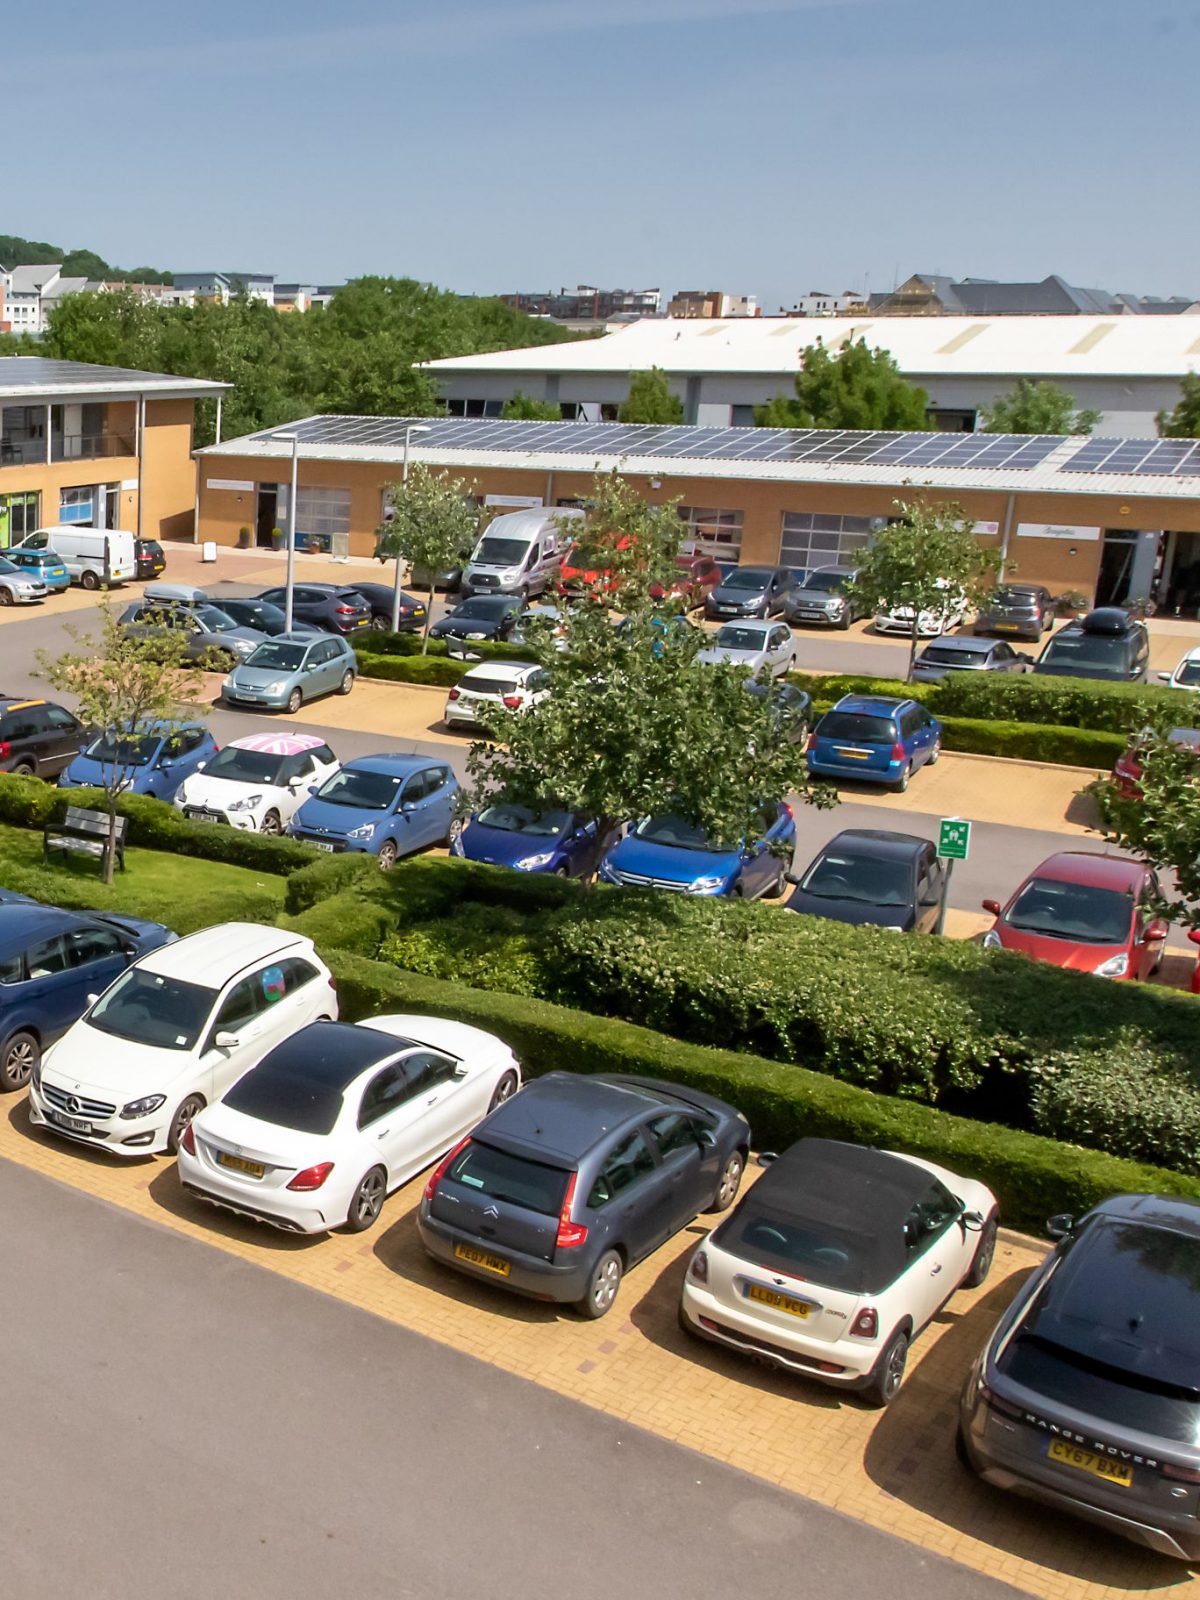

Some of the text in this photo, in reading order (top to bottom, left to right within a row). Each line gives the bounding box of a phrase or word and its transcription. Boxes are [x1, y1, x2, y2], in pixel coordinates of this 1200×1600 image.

[750, 1284, 781, 1306] LL09
[1025, 1413, 1085, 1443] RANGE
[1094, 1441, 1158, 1468] ROVER
[1051, 1441, 1130, 1480] CY67 BXM
